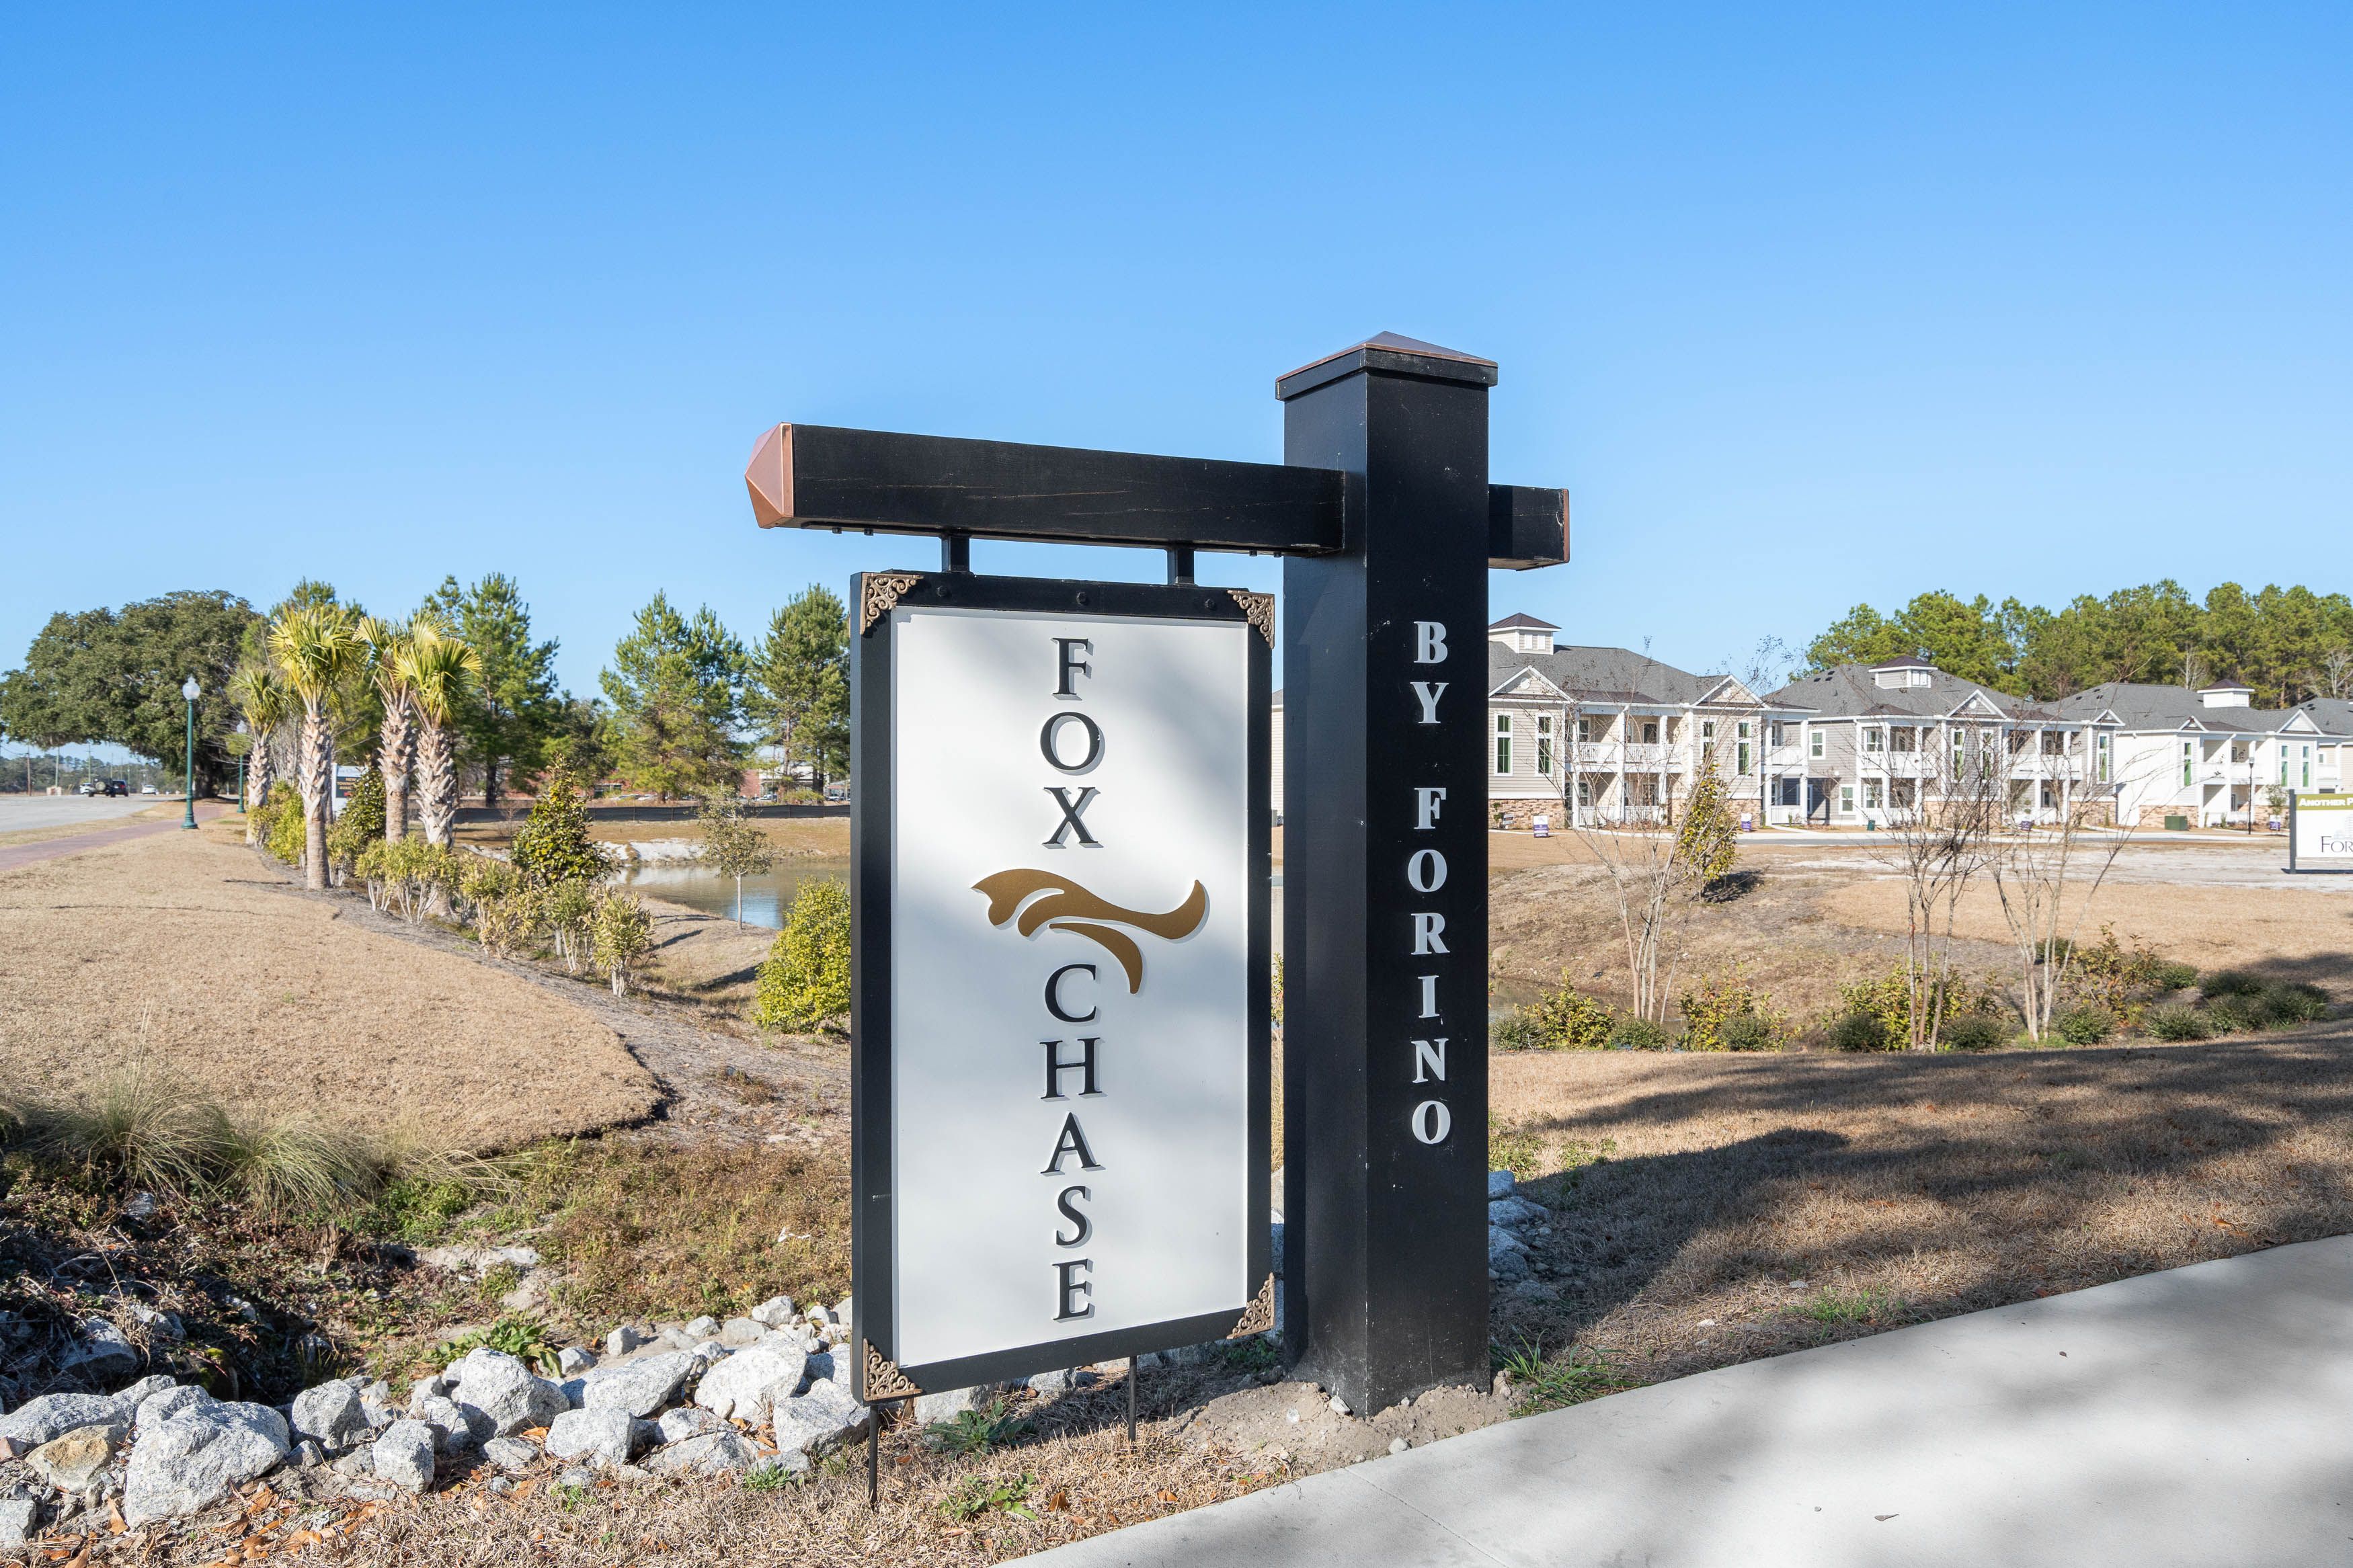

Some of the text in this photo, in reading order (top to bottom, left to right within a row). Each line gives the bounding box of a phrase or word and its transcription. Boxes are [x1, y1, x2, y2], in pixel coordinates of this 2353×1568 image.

[1039, 637, 1103, 1321] FOX CHASE
[1407, 621, 1451, 1145] BY FORINO
